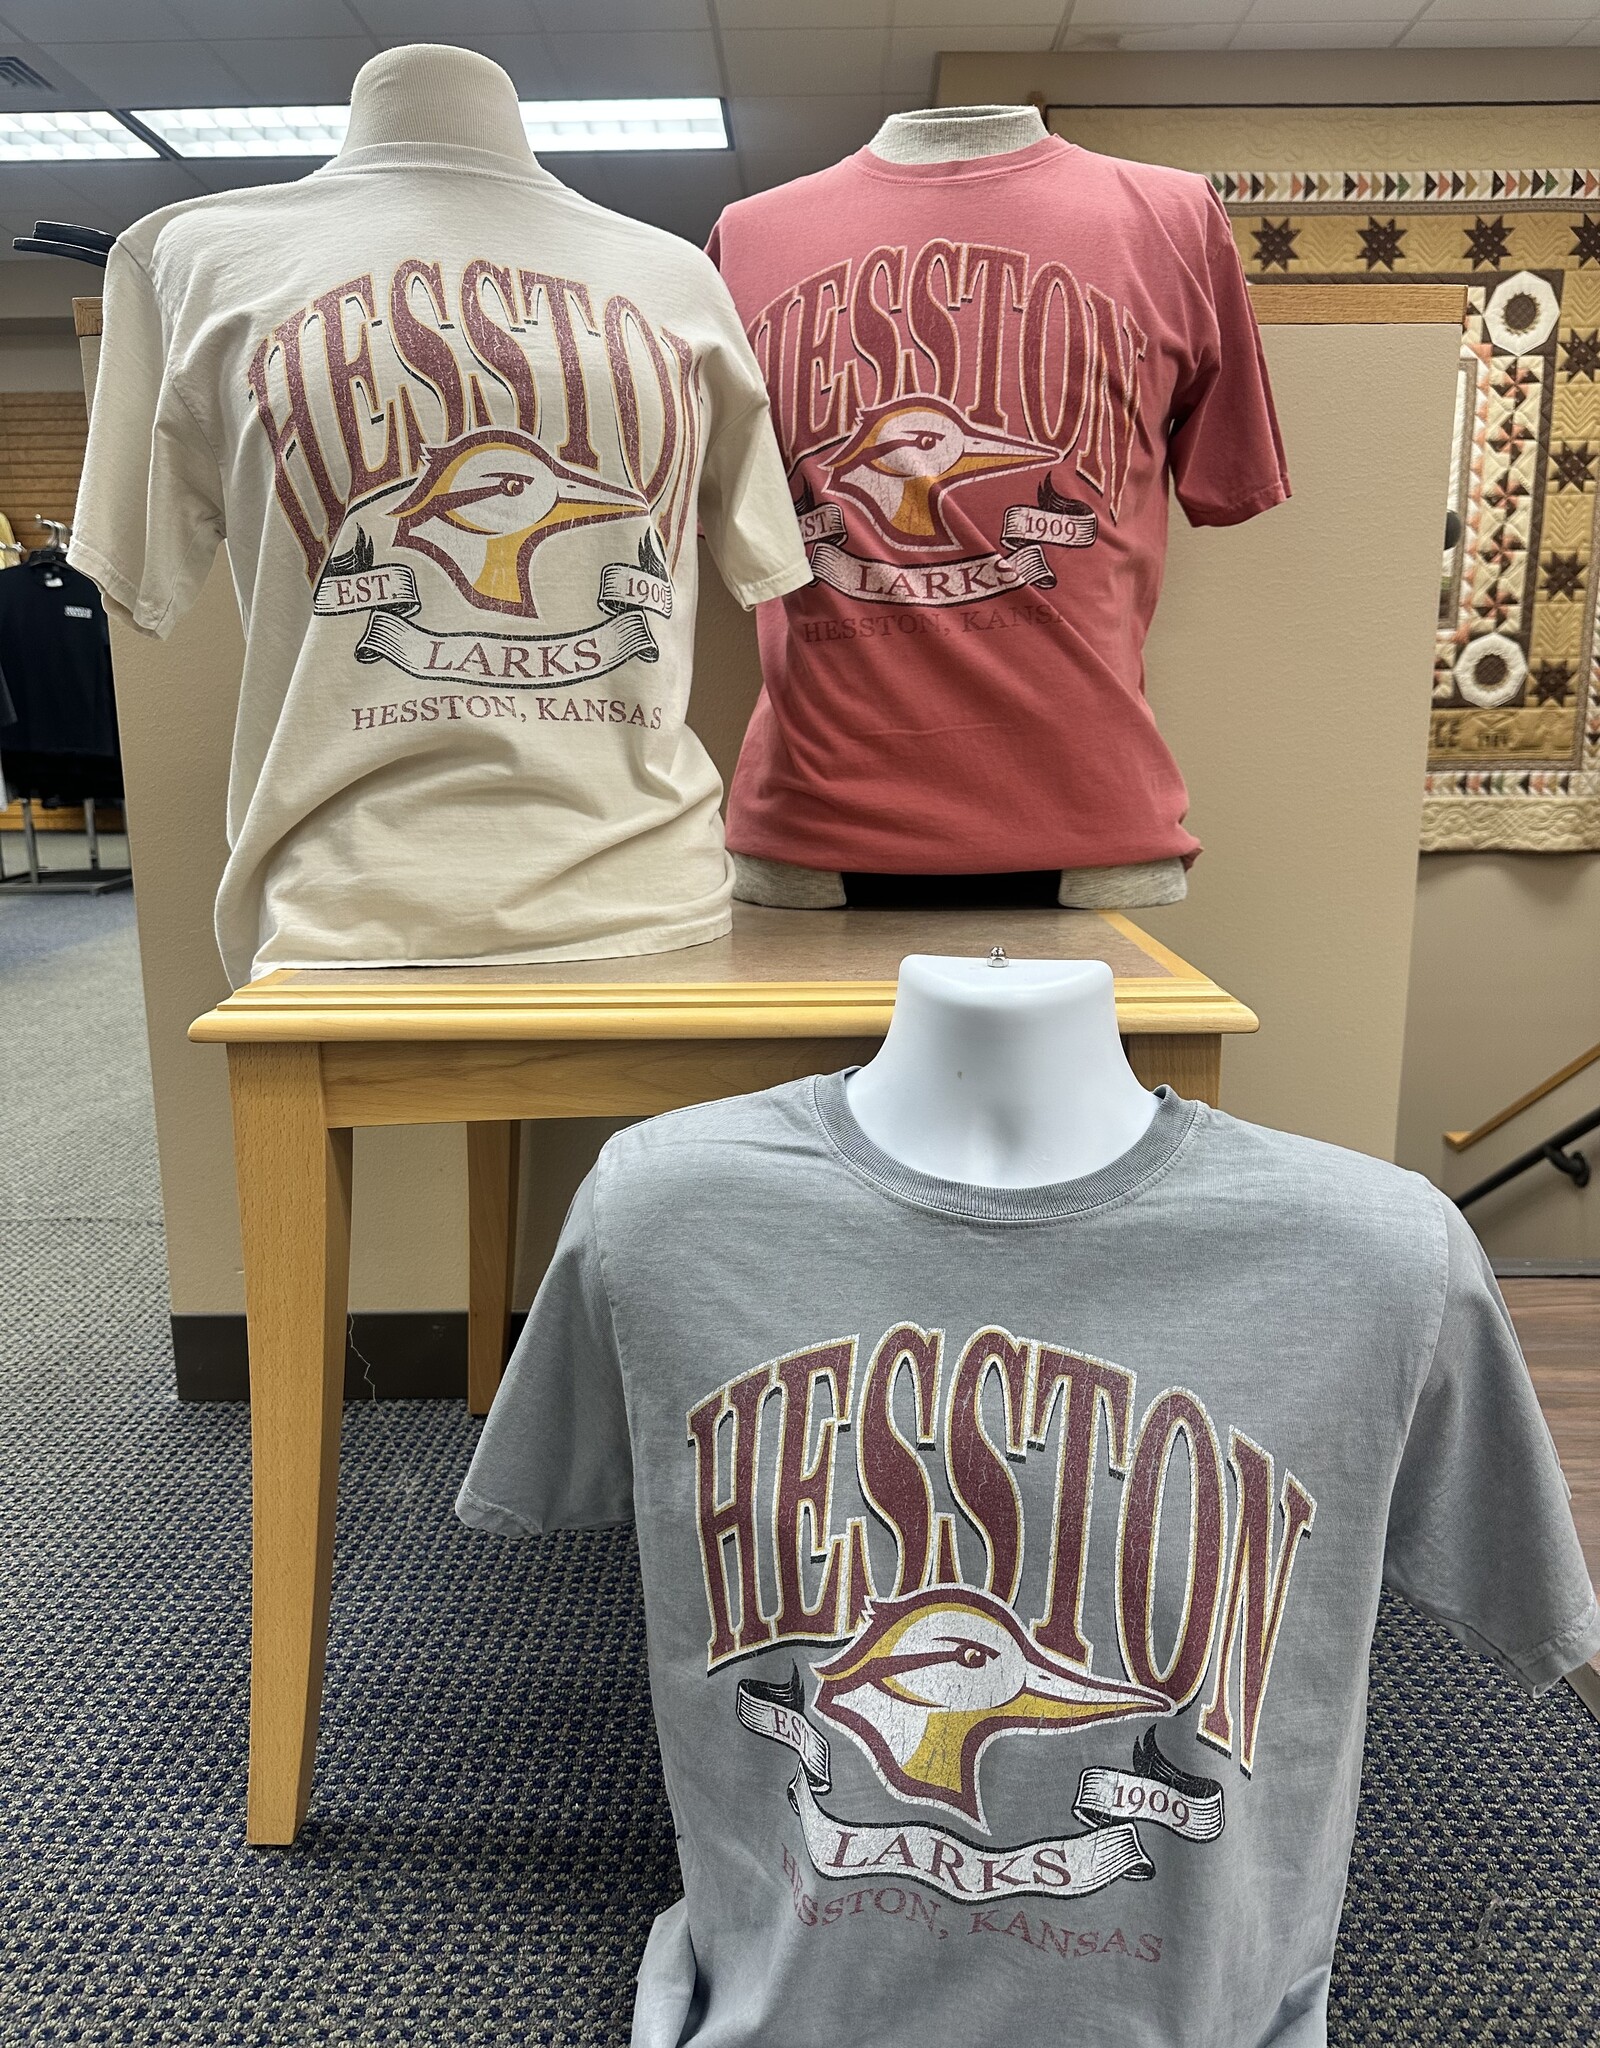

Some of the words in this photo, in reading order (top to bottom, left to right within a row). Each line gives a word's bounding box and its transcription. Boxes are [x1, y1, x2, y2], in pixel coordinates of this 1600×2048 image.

[798, 511, 833, 538] ST.
[1024, 515, 1079, 544] 1909
[335, 573, 398, 606] EST.
[855, 557, 1021, 599] LARKS
[802, 613, 950, 644] HESSTON,
[423, 637, 603, 679] LARKS
[352, 695, 527, 731] HESSTON,
[534, 697, 663, 731] KANSAS
[686, 1320, 1317, 1780] HESSTON
[1112, 1785, 1191, 1828] 1909
[826, 1829, 1073, 1894] LARKS
[967, 1909, 1163, 1963] KANSAS
